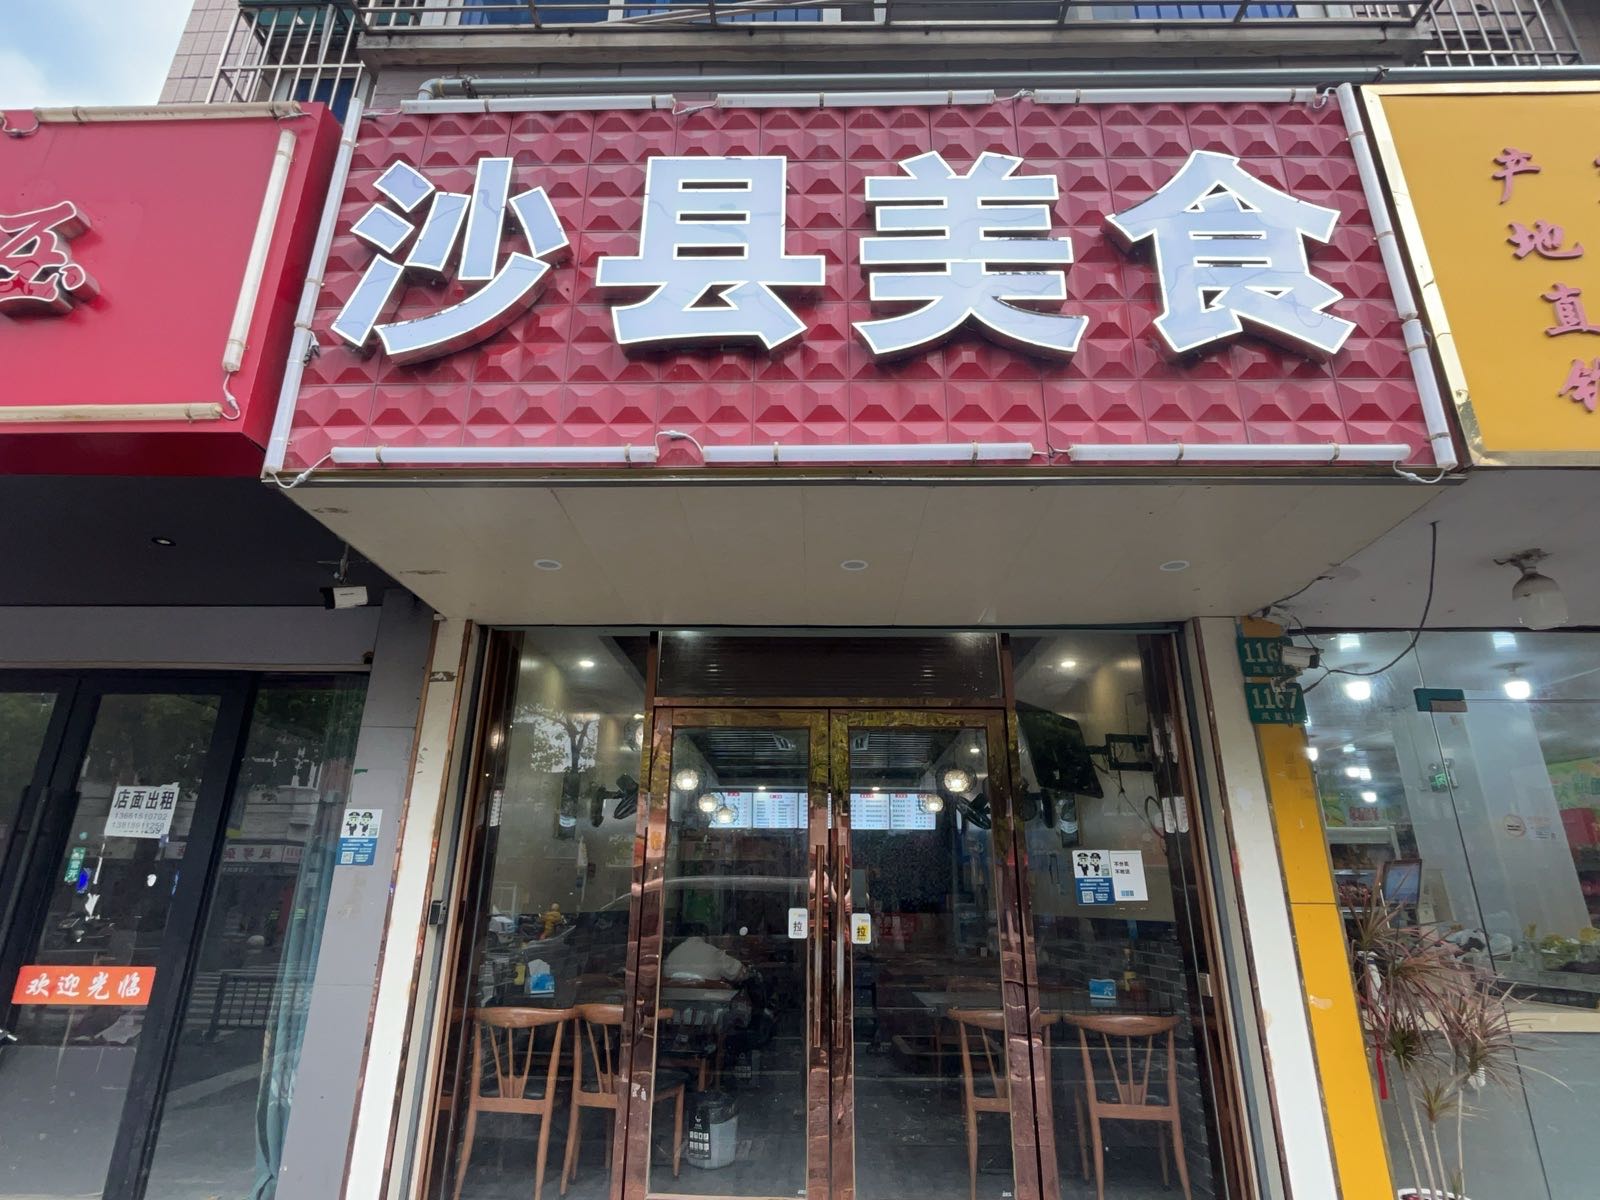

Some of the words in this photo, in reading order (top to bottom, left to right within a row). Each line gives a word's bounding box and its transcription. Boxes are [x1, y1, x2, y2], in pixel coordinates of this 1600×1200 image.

[330, 149, 1357, 356] 沙县美食
[1244, 642, 1282, 662] 116
[1251, 687, 1298, 709] 1167
[114, 789, 175, 810] 店面出租
[793, 920, 803, 932] 拉
[856, 925, 867, 937] 拉
[25, 971, 141, 1000] 欢迎光临
